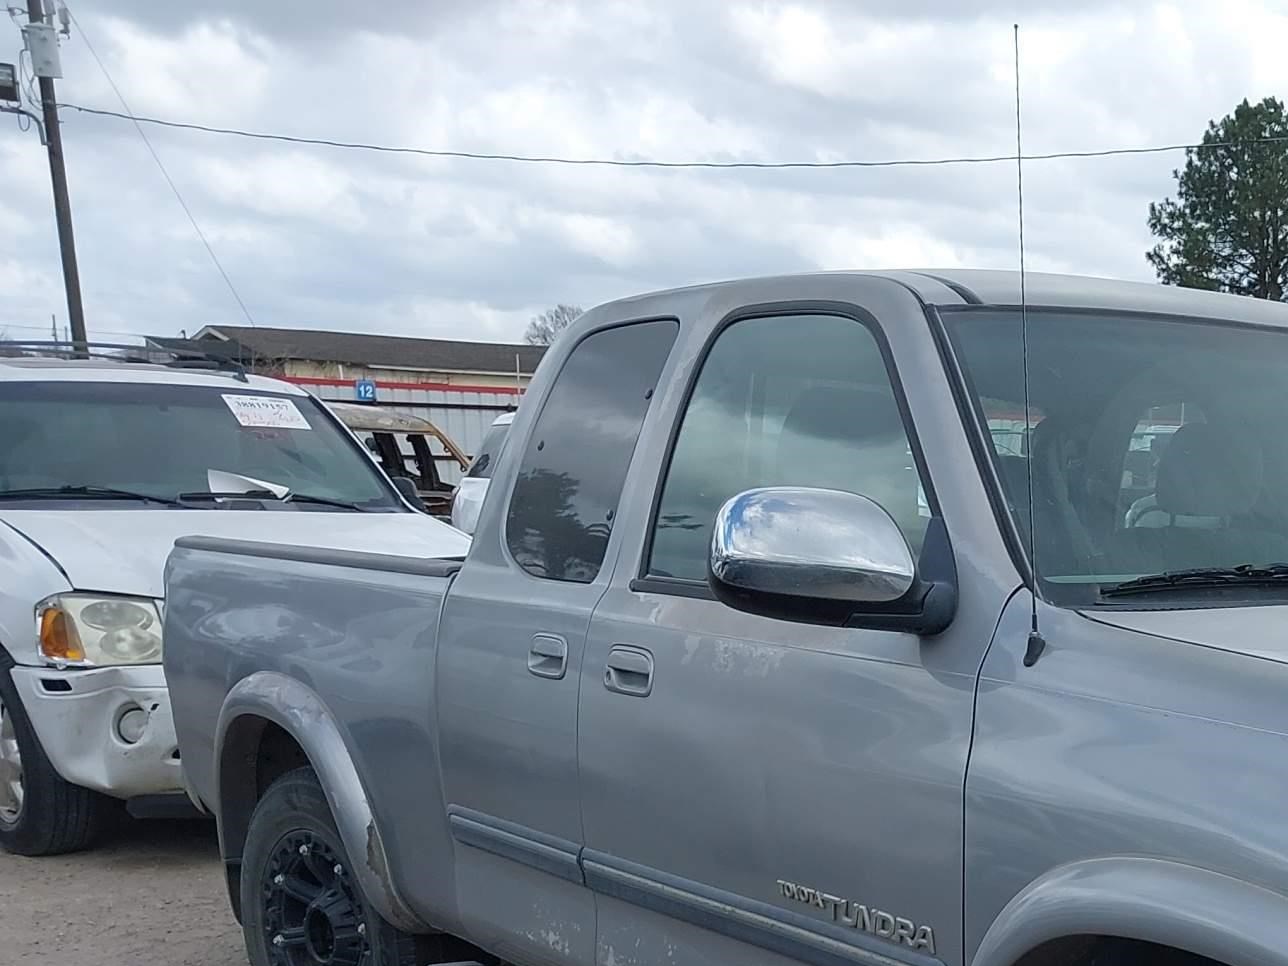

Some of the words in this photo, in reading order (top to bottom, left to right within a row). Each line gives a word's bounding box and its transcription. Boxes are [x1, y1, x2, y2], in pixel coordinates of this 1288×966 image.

[359, 384, 374, 398] 12
[776, 879, 825, 908] TOYOTA
[823, 893, 937, 955] TUNDRA
